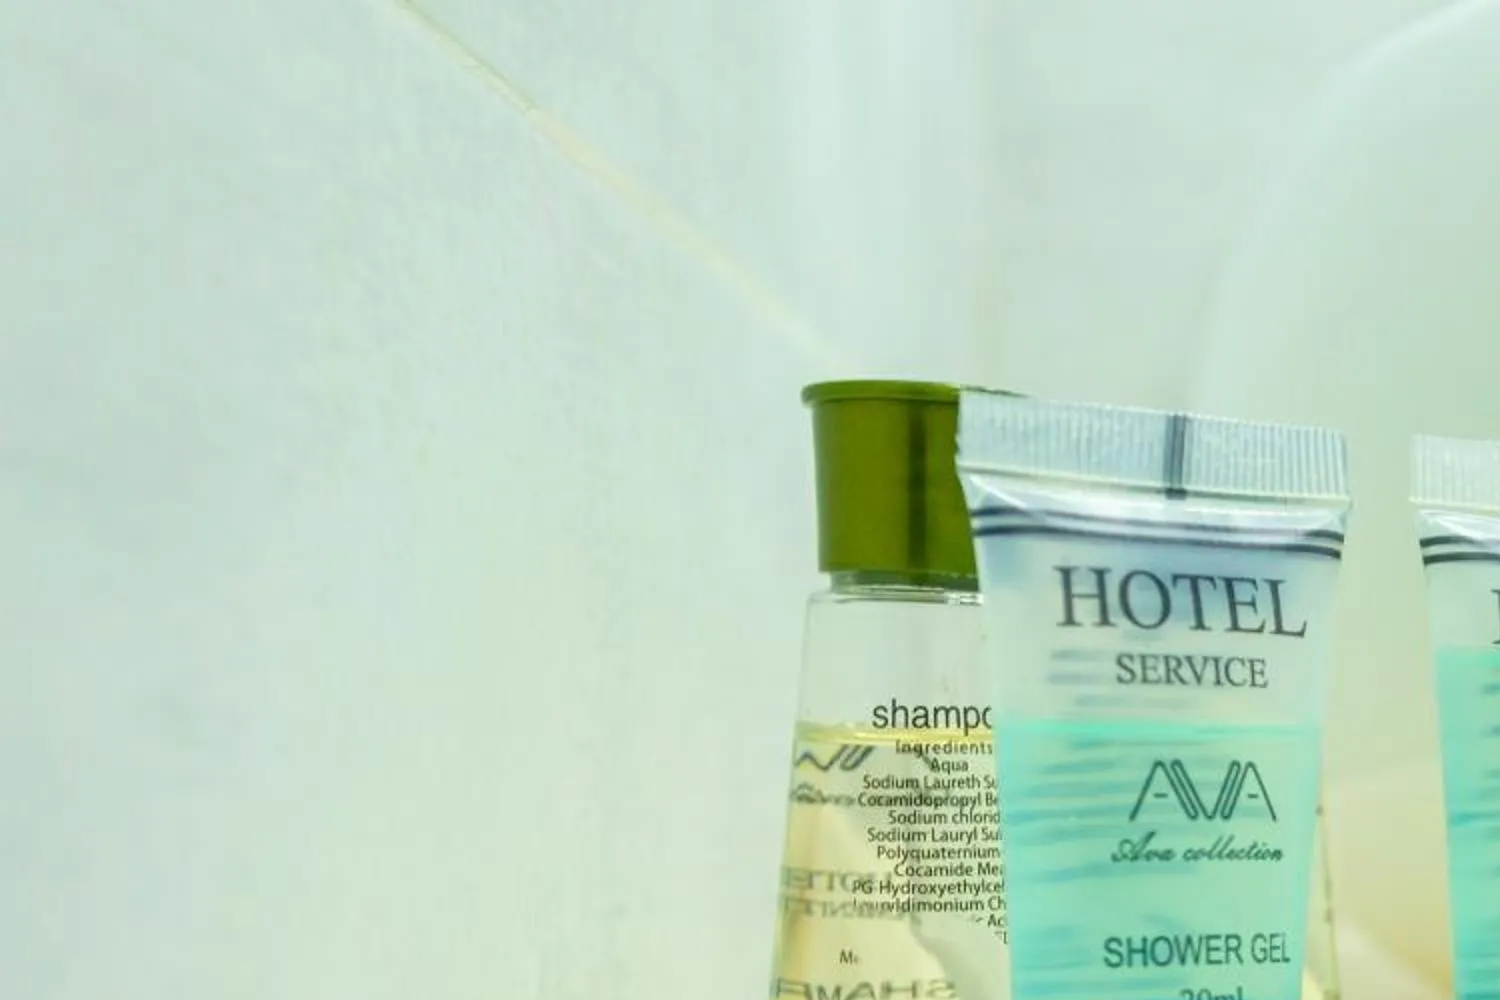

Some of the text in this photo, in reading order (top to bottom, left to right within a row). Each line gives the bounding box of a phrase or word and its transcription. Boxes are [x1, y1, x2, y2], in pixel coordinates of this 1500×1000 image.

[1052, 565, 1308, 638] HOTEL
[1115, 652, 1269, 689] SERVICE
[930, 757, 969, 774] Aqua
[863, 773, 919, 789] Sodium
[923, 773, 981, 789] Laureth
[1129, 759, 1278, 822] AVA
[857, 791, 981, 811] Cocamidopropyl
[888, 809, 947, 825] Sodium
[867, 826, 927, 842] Sodium
[931, 826, 977, 845] Lauryl
[877, 845, 1001, 865] Polyquaternium
[1110, 830, 1284, 862] Ava collection
[894, 862, 973, 877] Cocamide
[1103, 932, 1292, 968] SHOWER GEL
